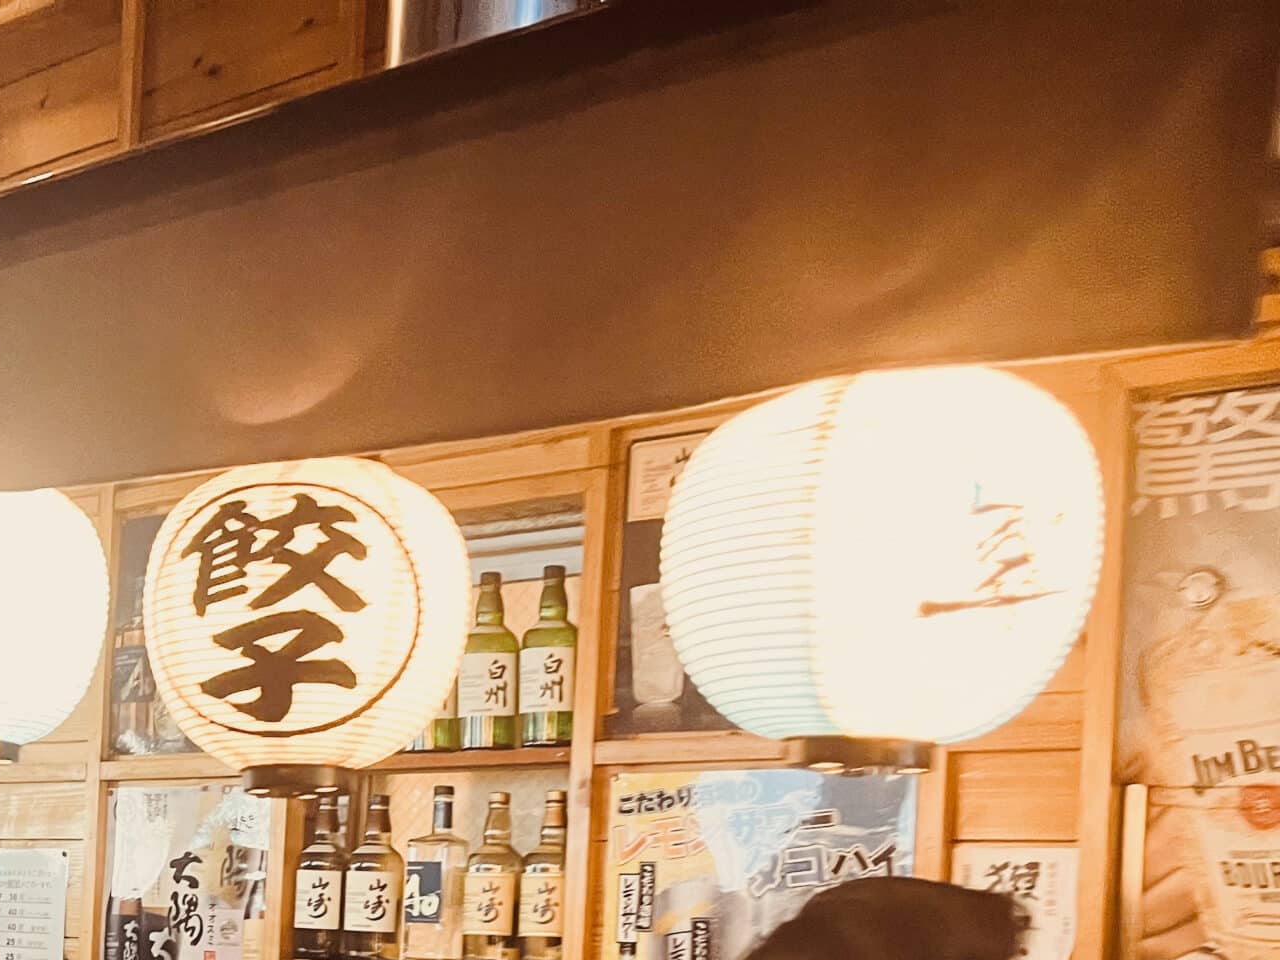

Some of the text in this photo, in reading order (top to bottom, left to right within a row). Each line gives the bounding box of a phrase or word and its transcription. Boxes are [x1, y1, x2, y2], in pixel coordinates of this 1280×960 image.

[180, 493, 368, 723] 餃子
[485, 660, 508, 709] 白州
[540, 653, 564, 703] 白州
[1235, 737, 1280, 774] BE
[306, 876, 332, 919] 山崎
[363, 878, 390, 921] 山崎
[477, 881, 504, 923] 山崎
[533, 882, 560, 924] 山崎
